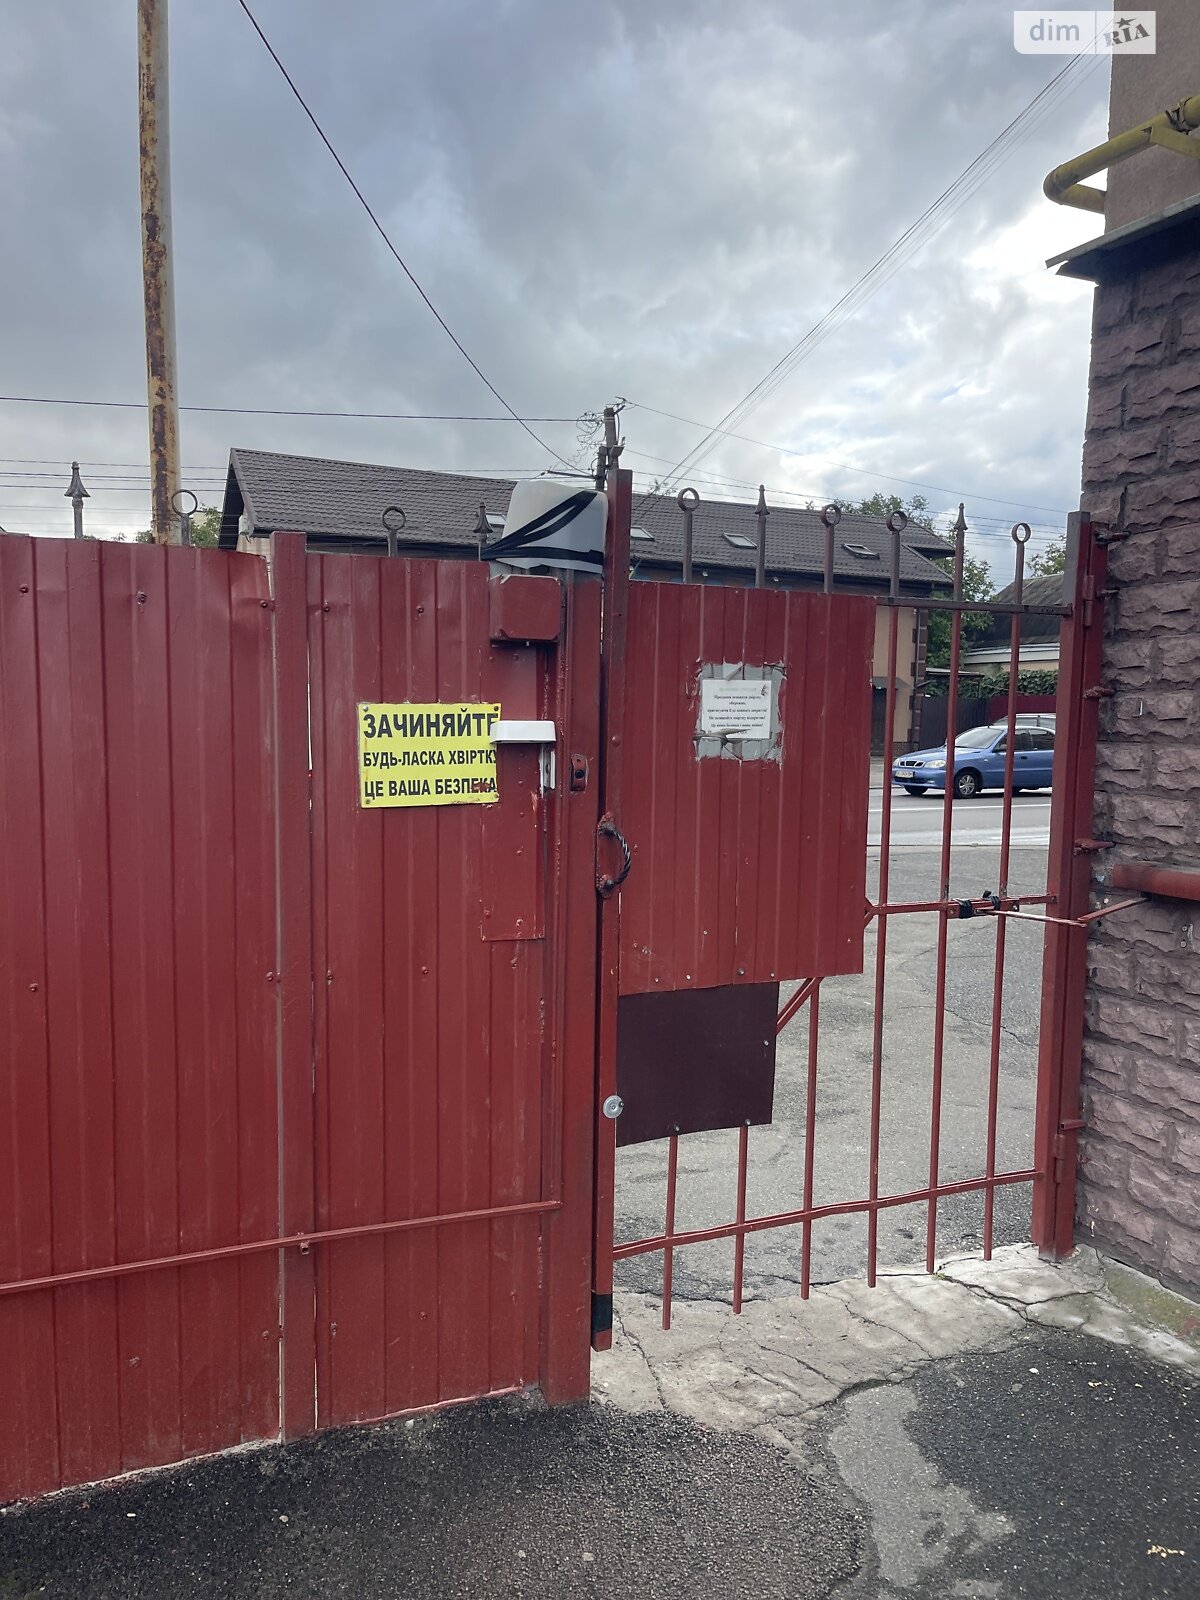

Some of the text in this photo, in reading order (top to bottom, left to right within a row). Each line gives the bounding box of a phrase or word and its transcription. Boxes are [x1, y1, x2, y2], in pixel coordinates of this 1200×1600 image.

[363, 707, 499, 739] ЗАЧИНЯЙТЕ
[363, 750, 445, 769] БУДЬ-ЛАСКА
[364, 780, 384, 799] ЦЕ
[388, 779, 431, 796] ВАША
